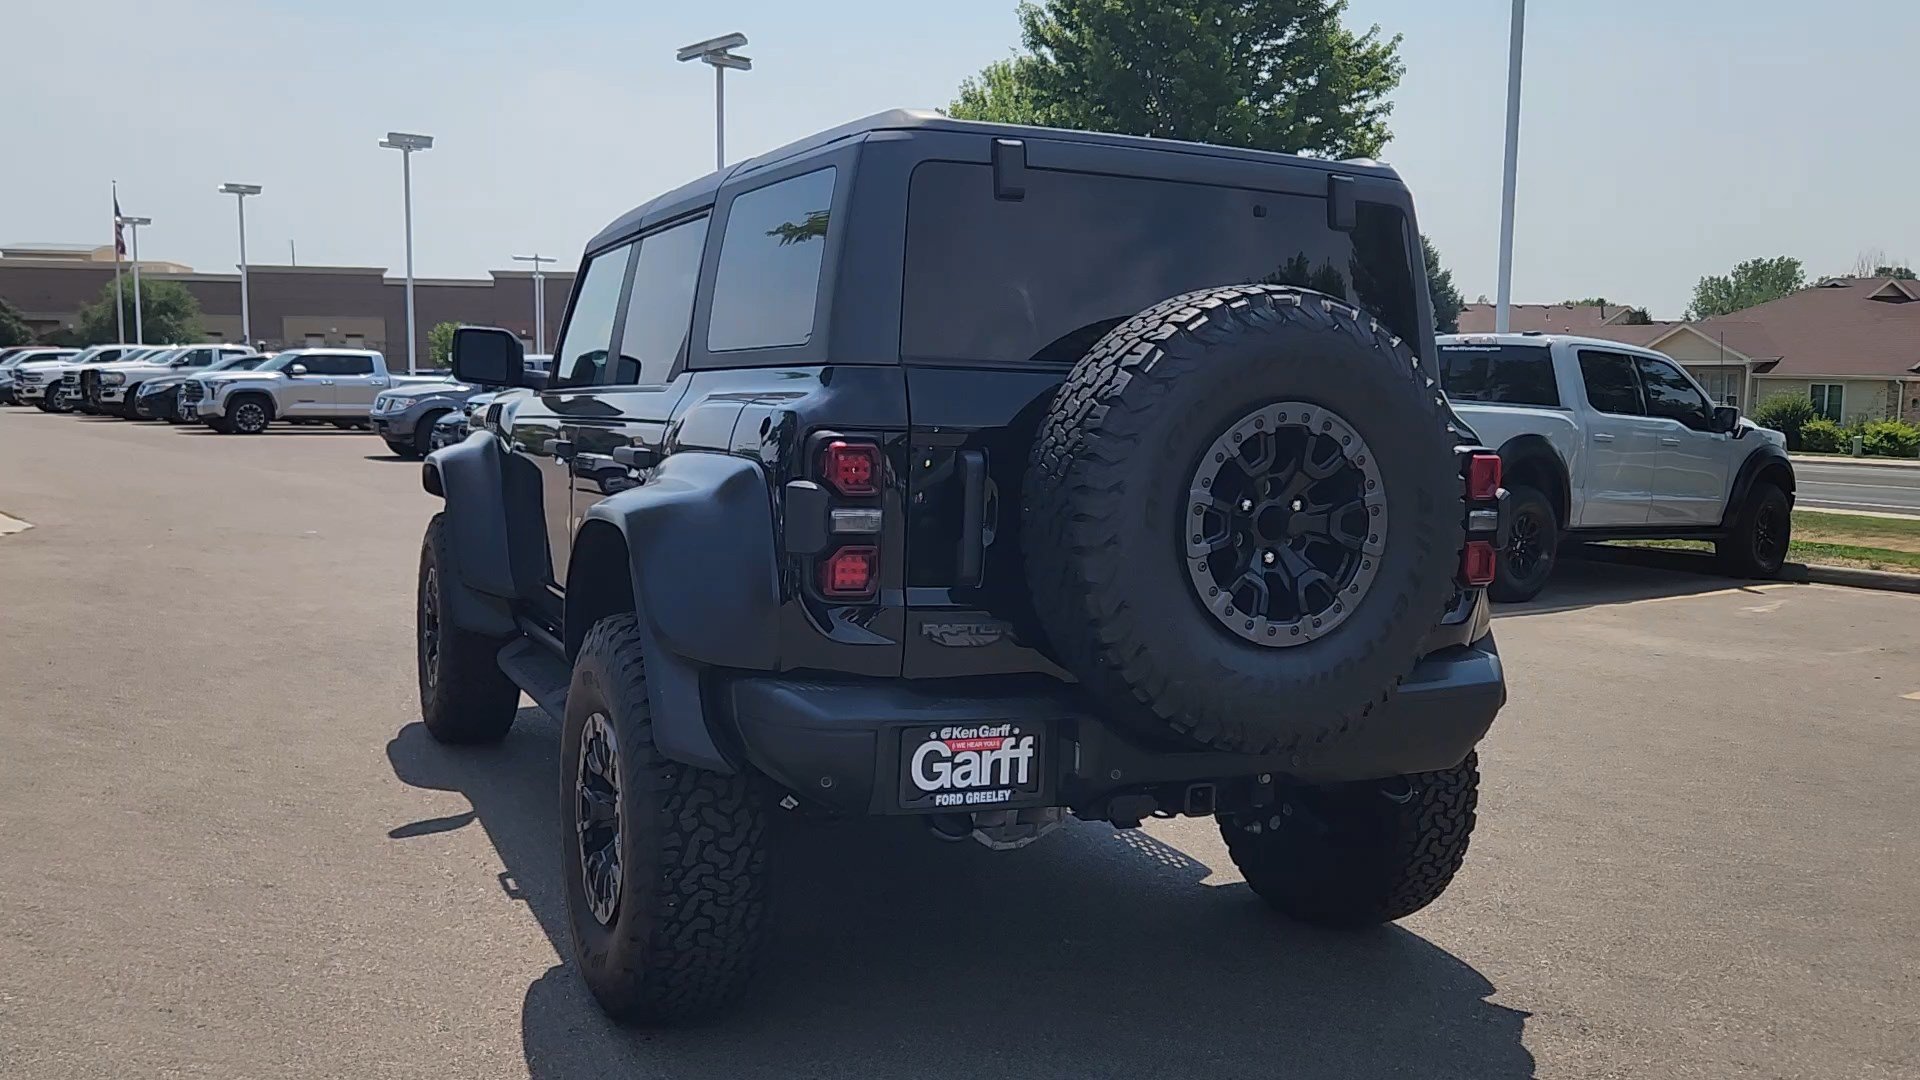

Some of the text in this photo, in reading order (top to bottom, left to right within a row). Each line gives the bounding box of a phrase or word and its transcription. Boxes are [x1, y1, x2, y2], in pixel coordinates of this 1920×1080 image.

[952, 727, 977, 739] Ken
[979, 725, 1011, 737] Garff
[911, 736, 1034, 791] Garff
[935, 790, 1011, 806] FORD GREELEY
